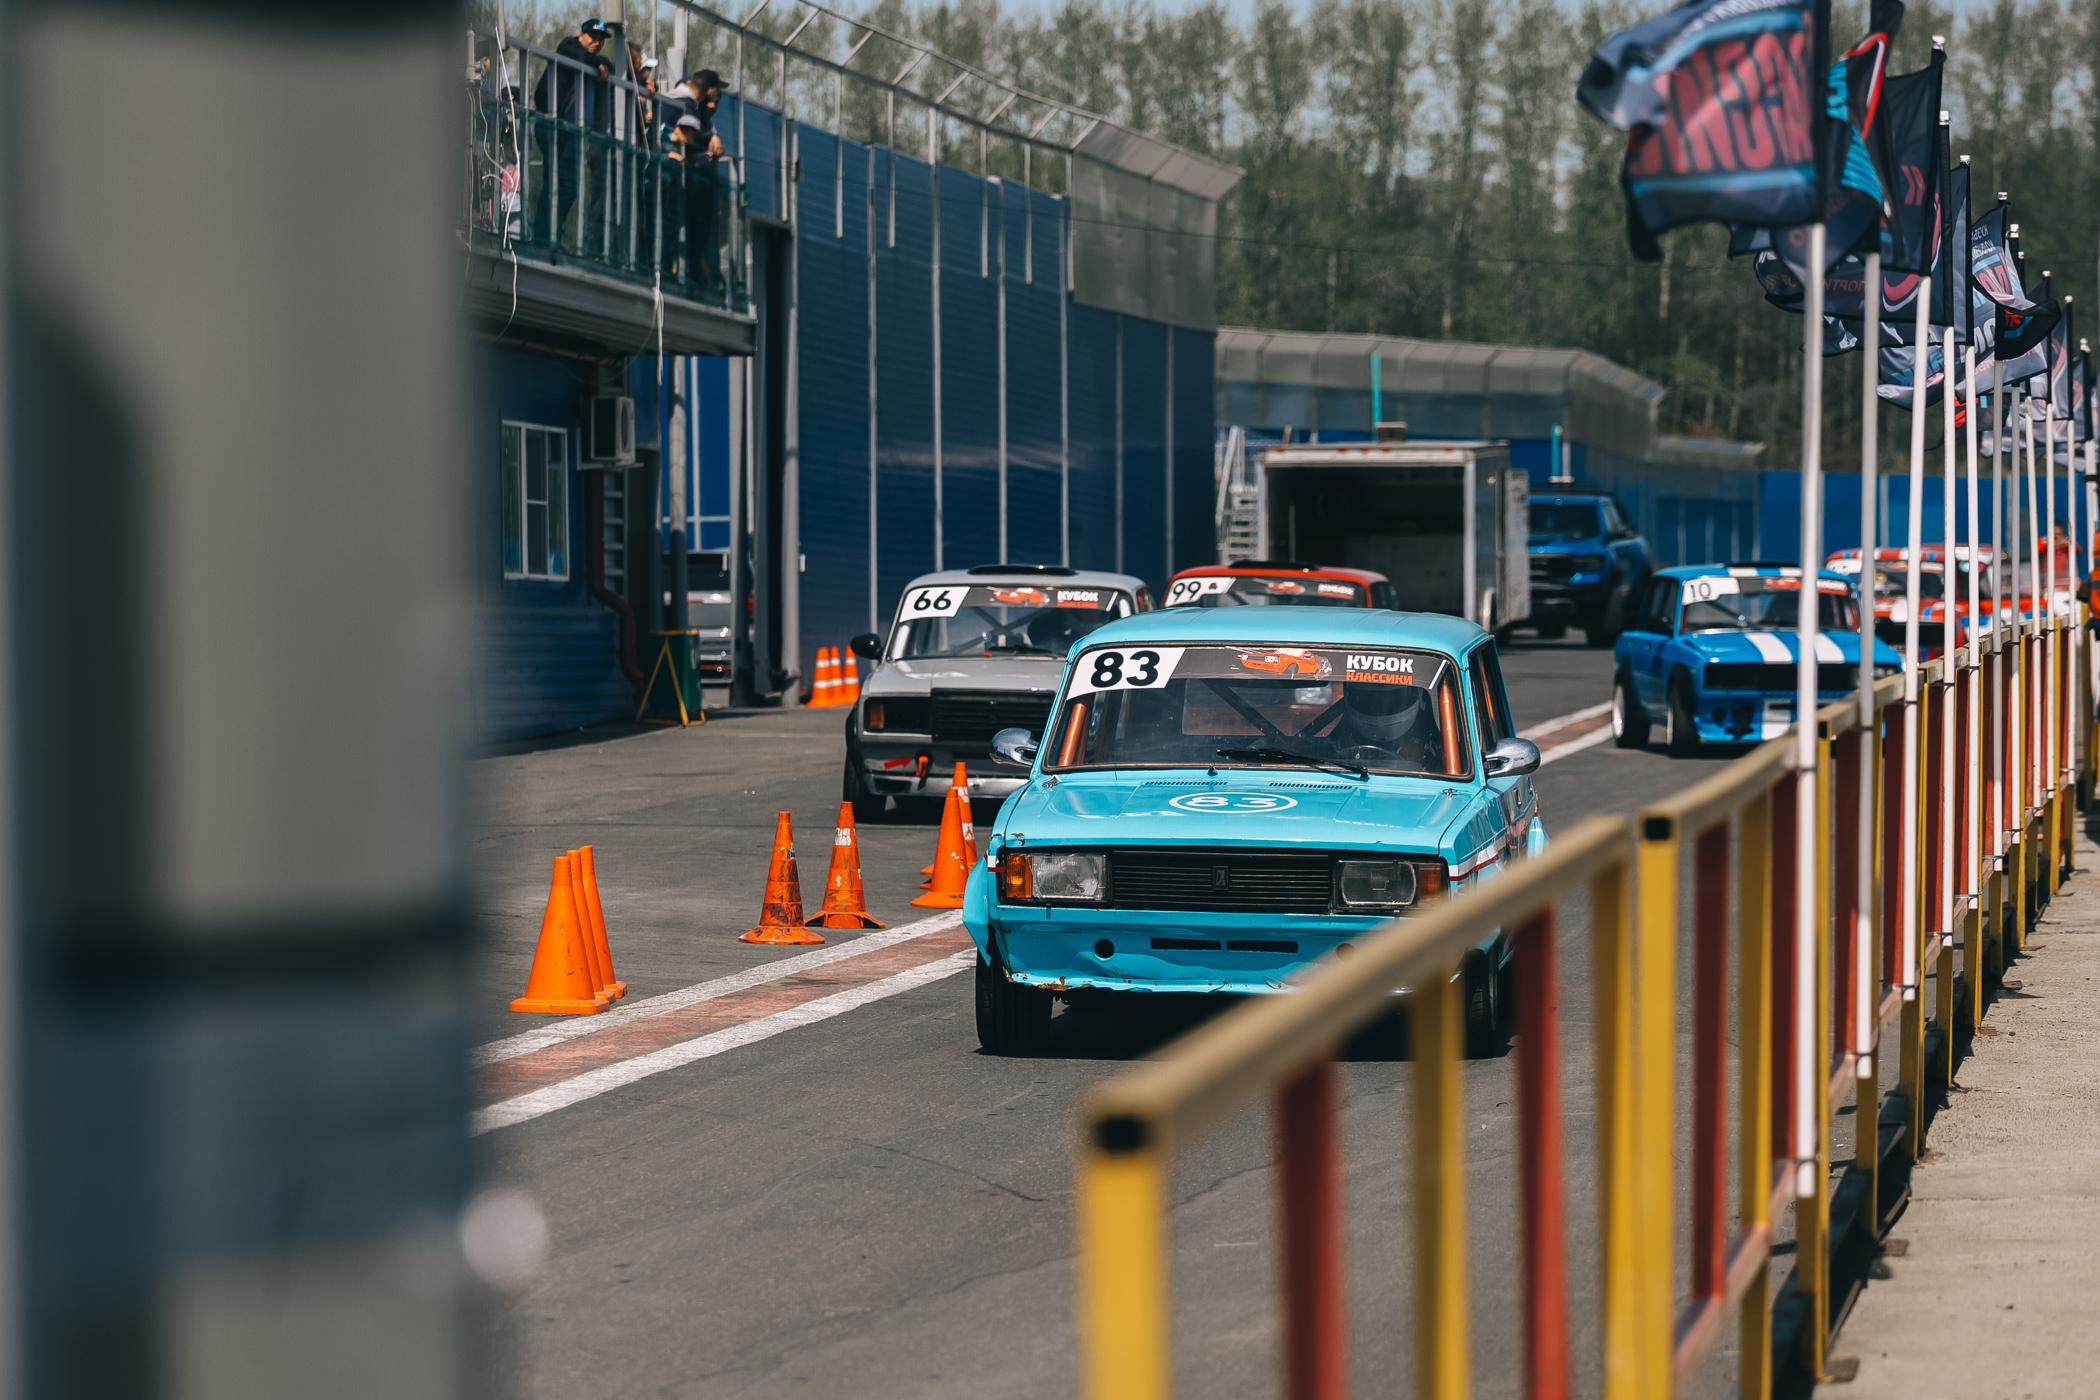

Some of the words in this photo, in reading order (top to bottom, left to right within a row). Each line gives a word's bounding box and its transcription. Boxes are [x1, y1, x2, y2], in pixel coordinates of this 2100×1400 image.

[913, 590, 951, 611] 66
[1057, 591, 1099, 602] КУБОК
[1172, 581, 1202, 602] 99
[1690, 583, 1712, 601] 10
[1090, 650, 1160, 688] 83
[1346, 654, 1413, 673] КУБОК
[1346, 671, 1413, 685] КЛАССИКИ
[1186, 797, 1278, 808] 83
